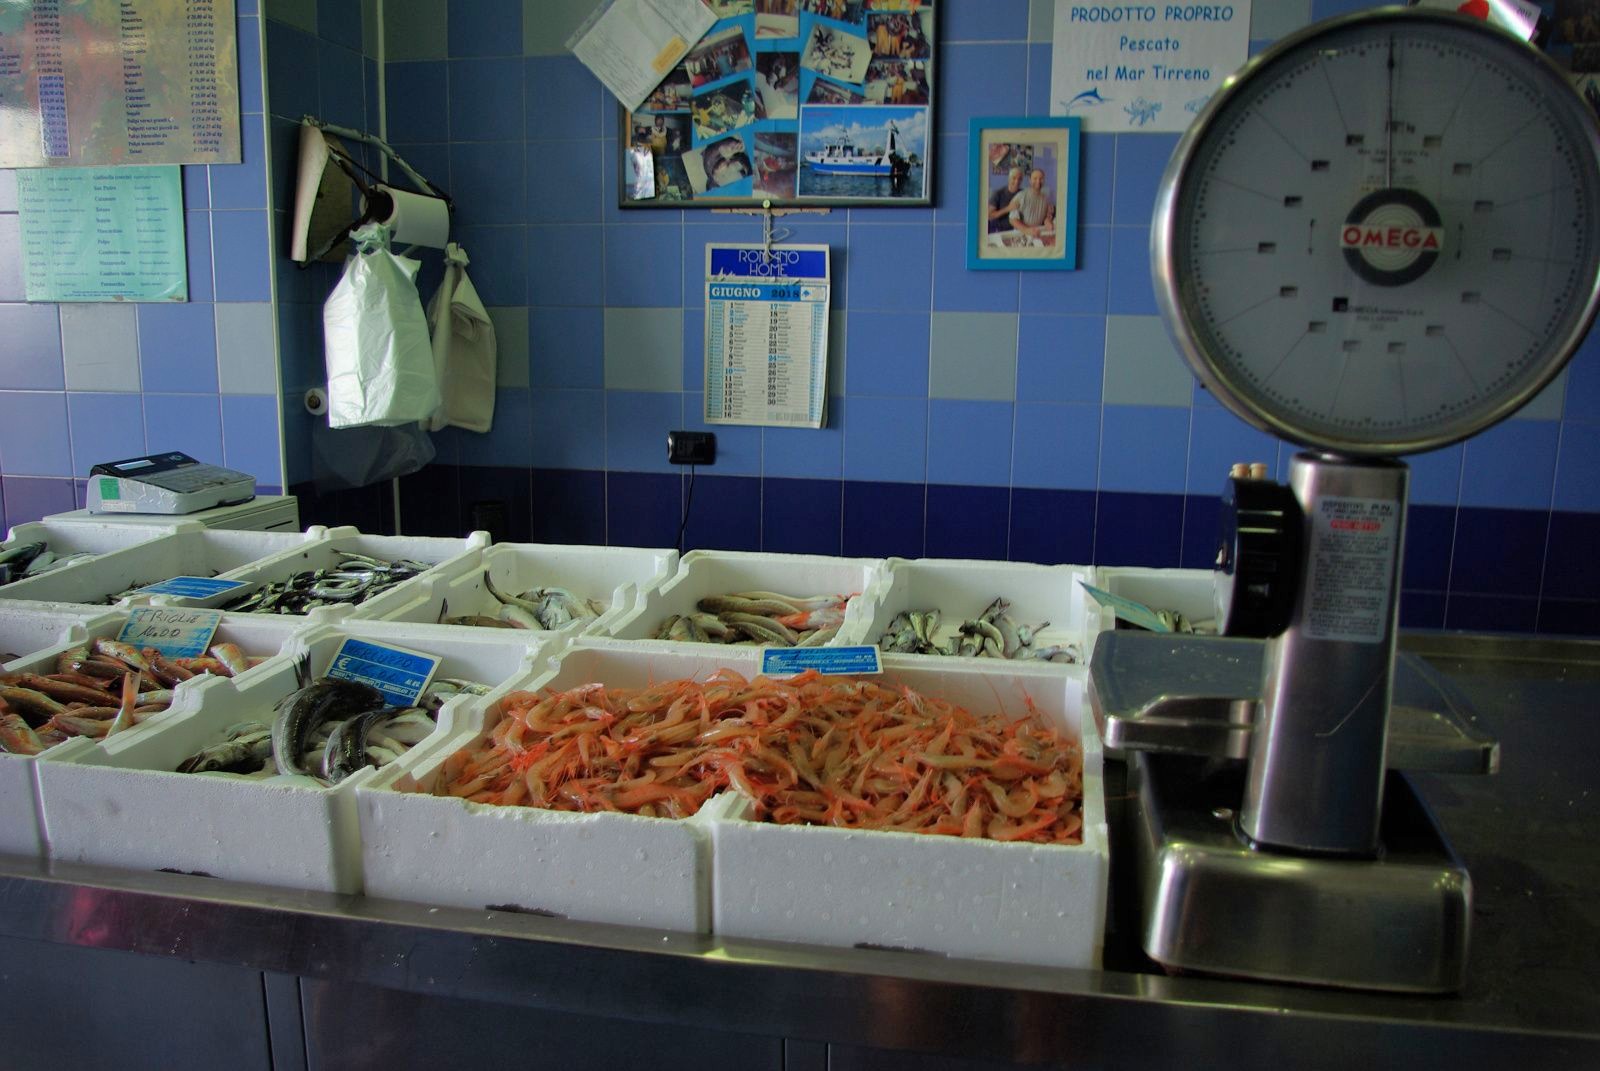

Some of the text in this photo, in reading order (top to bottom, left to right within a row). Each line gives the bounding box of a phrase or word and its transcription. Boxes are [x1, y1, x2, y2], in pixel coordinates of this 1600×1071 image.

[1071, 6, 1234, 22] PRODOTTO PROPRIO
[1120, 36, 1180, 51] Pescato
[1086, 65, 1210, 80] nel Mar Tirreno
[1343, 226, 1439, 249] OMEGA
[749, 263, 788, 277] HOME
[711, 287, 800, 299] GIUGNO 2018
[136, 608, 201, 624] TRIGLIE
